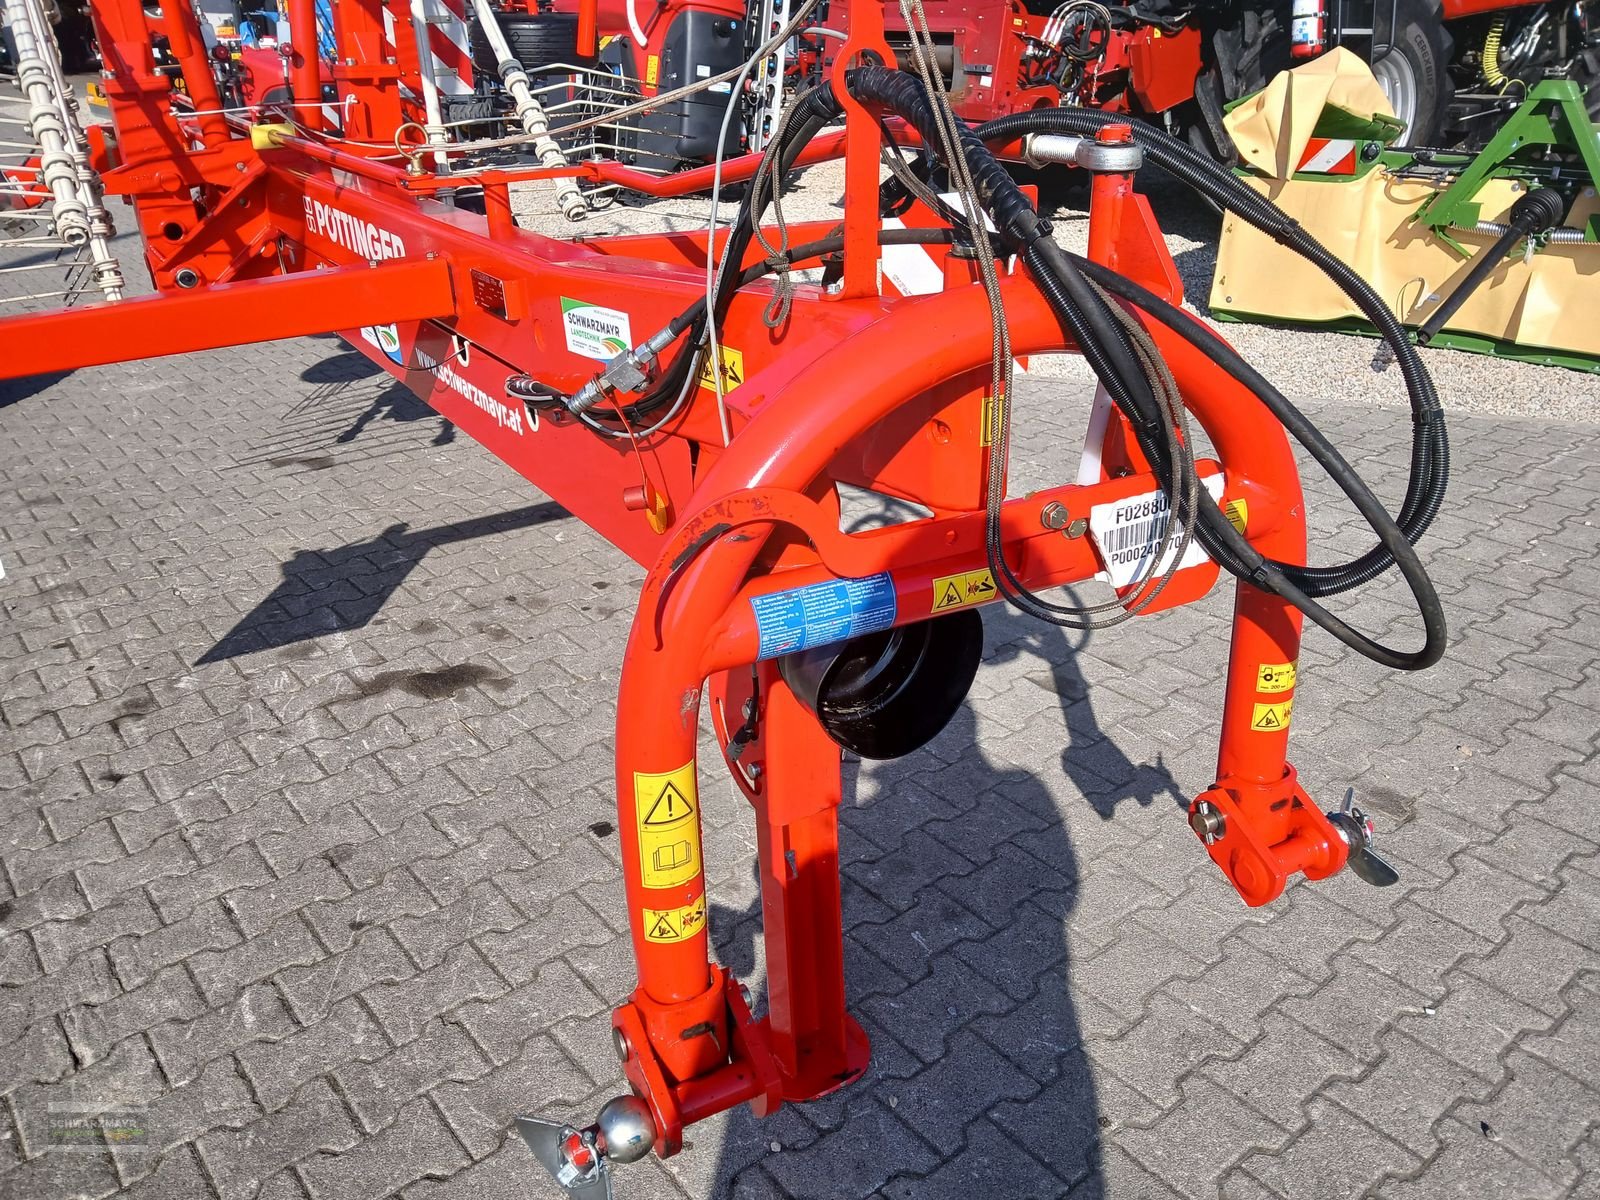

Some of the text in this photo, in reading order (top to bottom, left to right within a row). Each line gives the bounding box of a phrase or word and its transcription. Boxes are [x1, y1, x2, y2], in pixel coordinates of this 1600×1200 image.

[567, 312, 620, 337] SCHWARZMAYR
[570, 328, 601, 343] LANDTECHNIK
[415, 347, 524, 436] www.schwarzmayr.at
